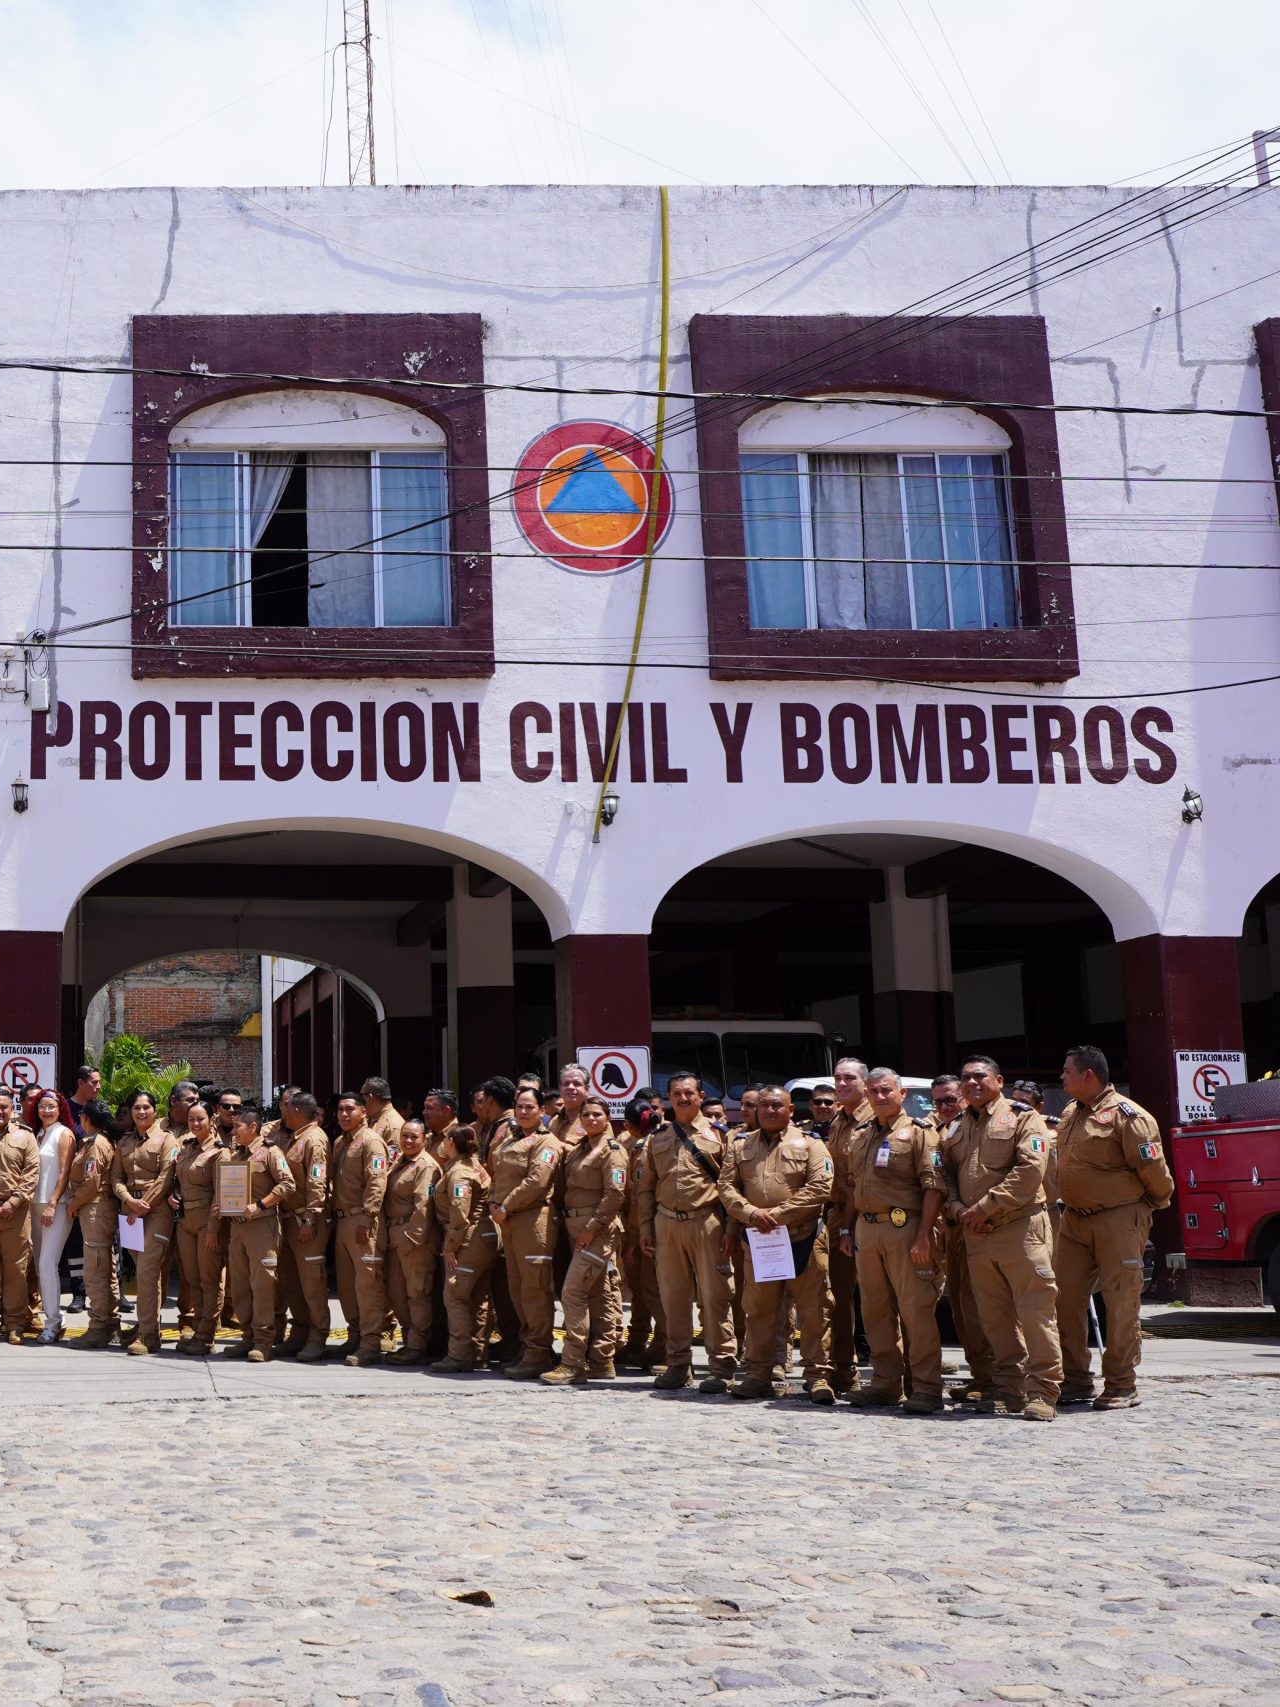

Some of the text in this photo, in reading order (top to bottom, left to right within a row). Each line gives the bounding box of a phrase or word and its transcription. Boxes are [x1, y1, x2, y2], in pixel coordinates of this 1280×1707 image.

[30, 700, 1177, 785] PROTECCION CIVIL Y BOMBEROS
[1, 1046, 50, 1055] ESTACIONARSE
[1192, 1054, 1240, 1062] ESTACIONARSE
